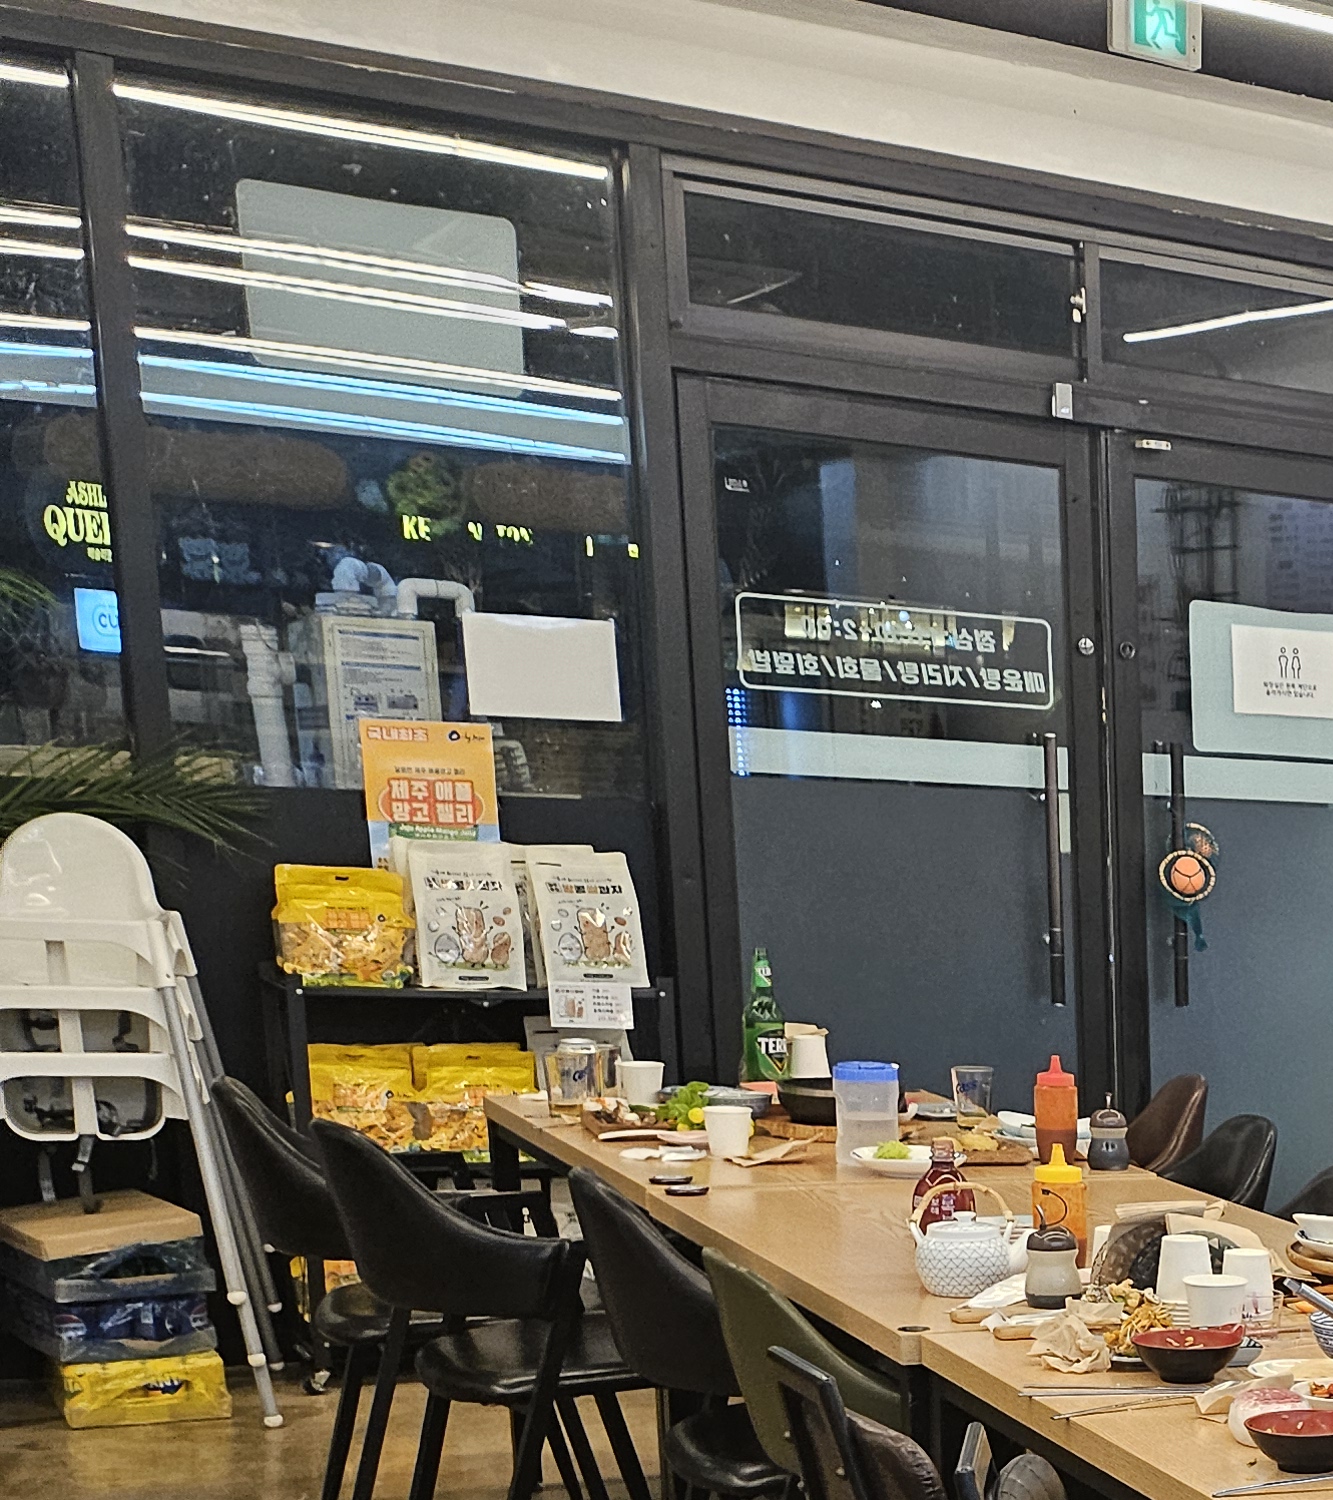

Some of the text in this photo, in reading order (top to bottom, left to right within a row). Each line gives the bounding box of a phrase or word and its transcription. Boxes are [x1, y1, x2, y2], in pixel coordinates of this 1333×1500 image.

[367, 725, 429, 743] 국내최초
[389, 779, 474, 803] 제주 애플
[391, 801, 477, 825] 망고 젤리
